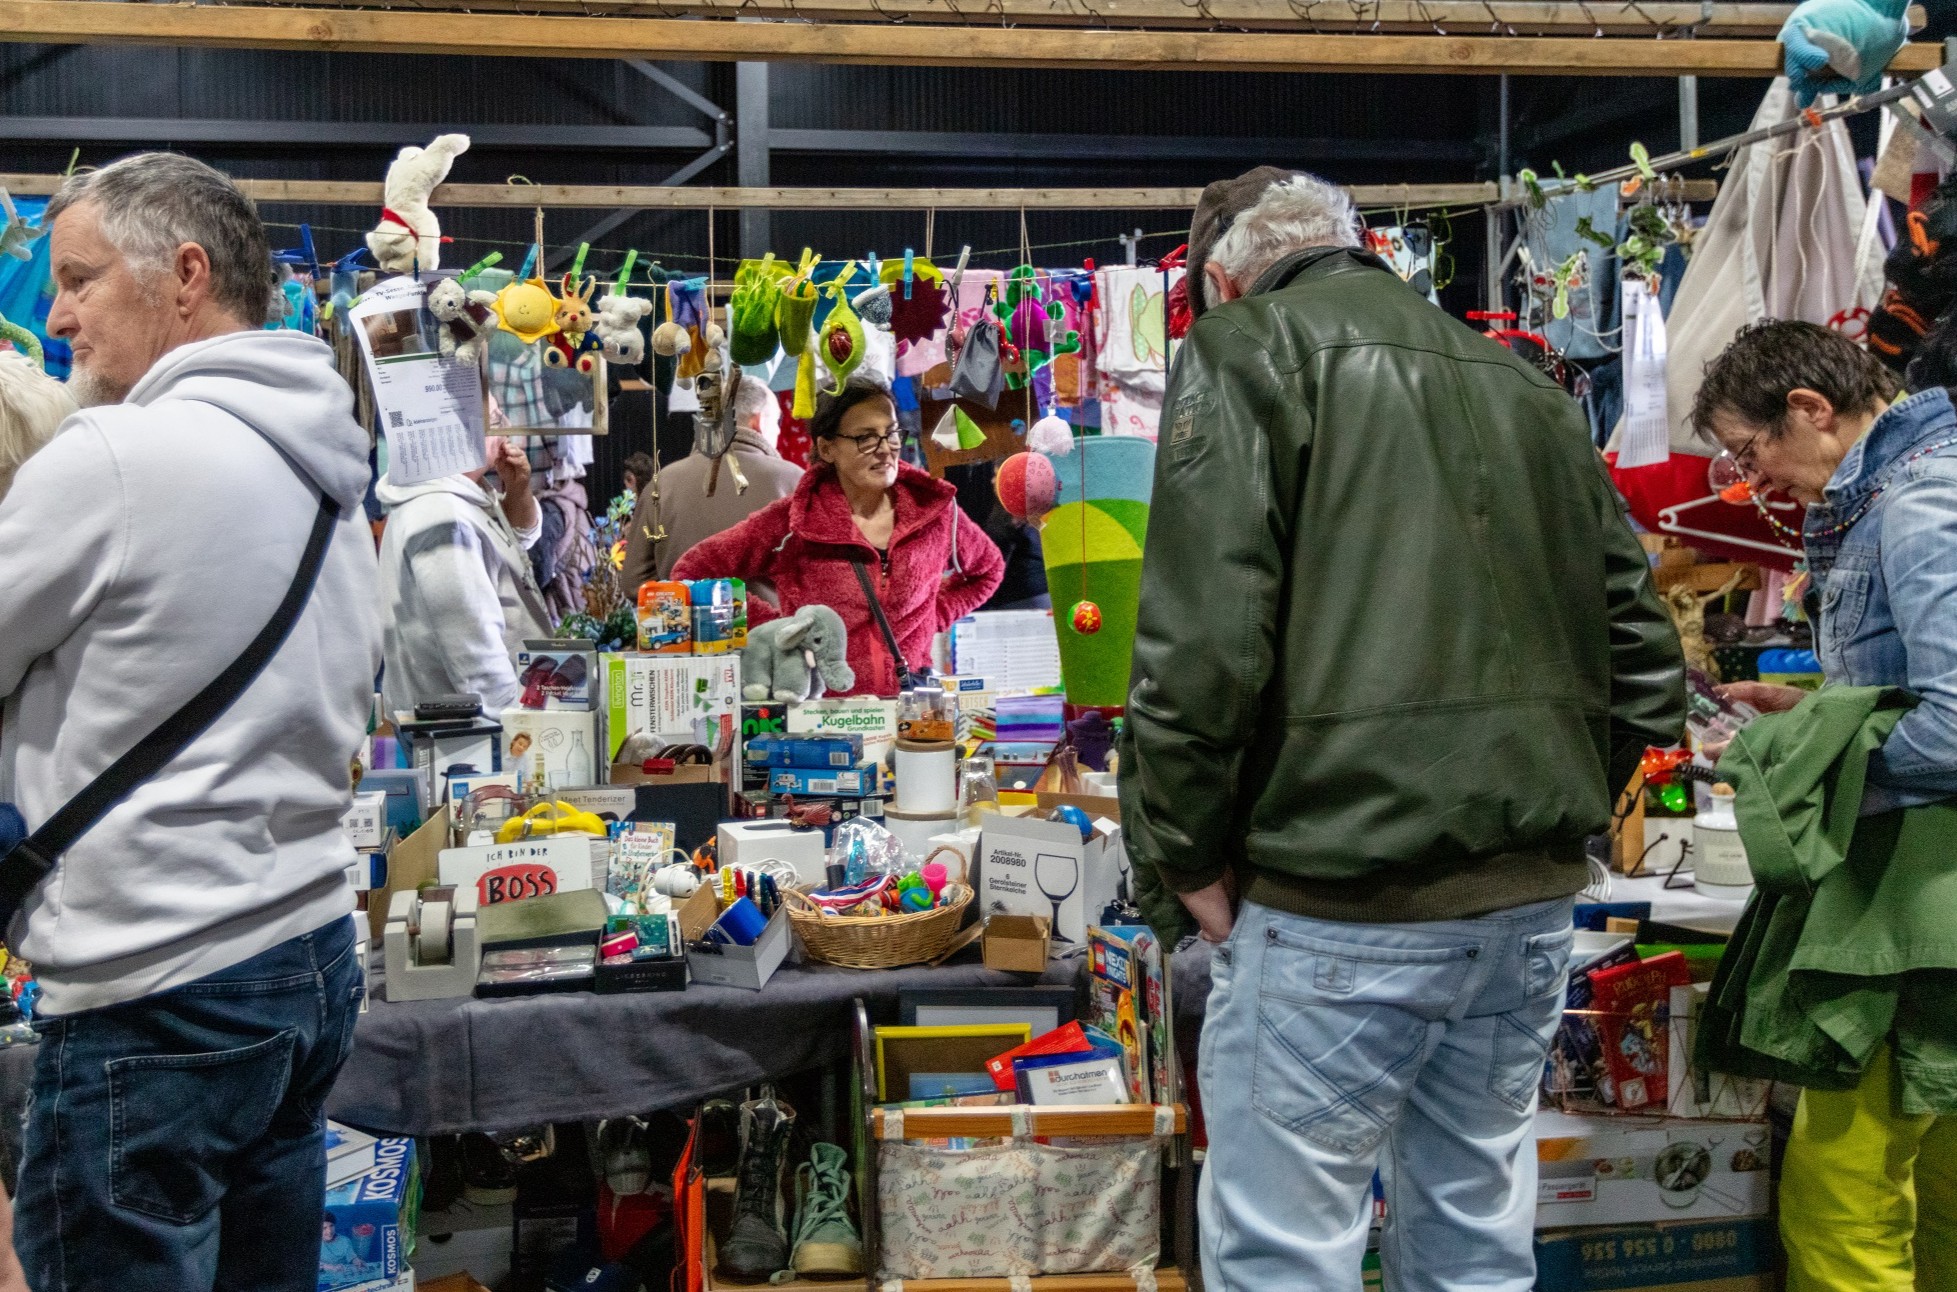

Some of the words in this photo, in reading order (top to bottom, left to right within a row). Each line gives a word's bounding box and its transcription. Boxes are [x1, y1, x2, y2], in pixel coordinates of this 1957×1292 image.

[743, 708, 782, 735] nic
[822, 714, 885, 728] Kugelbahn
[582, 795, 626, 803] Tenderizer
[486, 850, 503, 862] ICH
[508, 848, 526, 858] BIN
[530, 848, 548, 856] DER
[993, 849, 1022, 858] Artikel-Nr.
[990, 855, 1027, 867] 2008980
[486, 870, 554, 904] BOSS
[989, 877, 1027, 888] Gerolsteiner
[989, 884, 1027, 894] Sternkelche
[1056, 1070, 1107, 1082] durchatmen
[387, 1229, 397, 1274] KOSMOS
